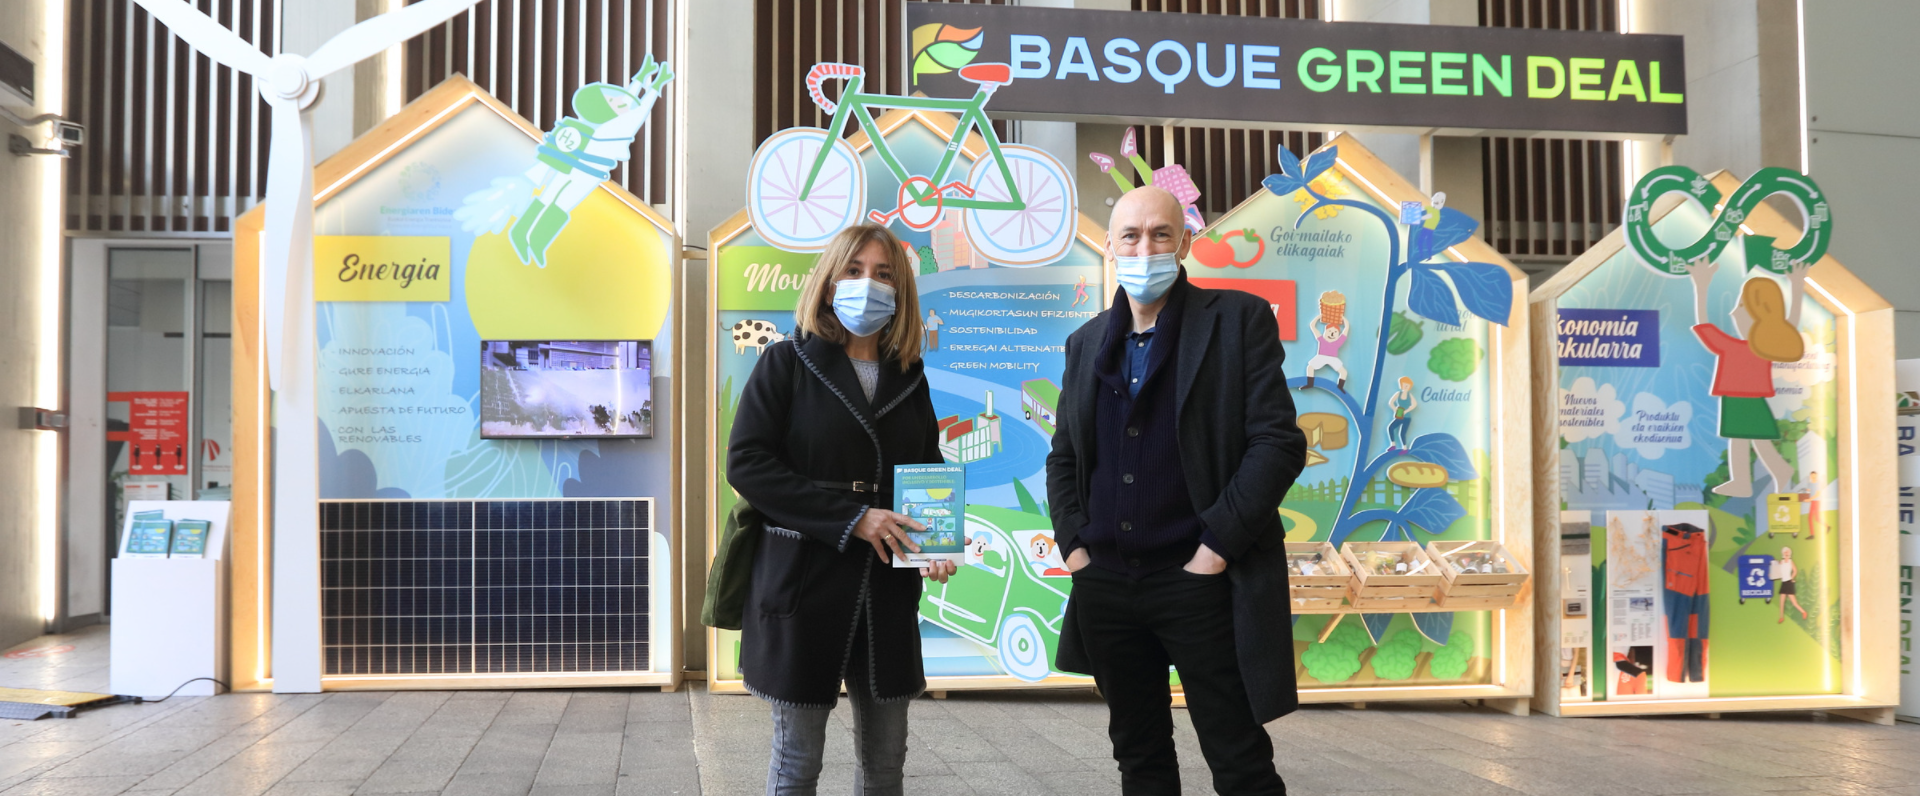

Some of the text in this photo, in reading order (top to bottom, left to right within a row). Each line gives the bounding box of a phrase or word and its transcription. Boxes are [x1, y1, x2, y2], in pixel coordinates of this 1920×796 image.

[1009, 34, 1684, 103] BASQUE GREEN DEAL
[432, 206, 456, 215] Bide
[1270, 225, 1353, 243] Goi-mailako
[1276, 243, 1346, 262] elikagaiak
[338, 253, 441, 289] Energia
[949, 290, 1060, 301] DESCARBONIZACIÓN
[949, 309, 1099, 319] MUGIKORTASUN EFIZIENTE
[949, 326, 1038, 335] SOSTENIBILIDAD
[1557, 314, 1639, 337] konomia
[338, 346, 415, 356] INNOVACIÓN
[950, 344, 1066, 353] ERREGAI ALTERNATIB
[1557, 337, 1643, 359] rkularra
[338, 367, 431, 376] GURE ENERGIA
[950, 361, 1040, 373] GREEN MOBILITY
[338, 387, 415, 395] ELKARLANA
[1421, 386, 1472, 403] Calidad
[1564, 394, 1598, 405] Nuevos
[337, 406, 467, 415] APUESTA DE FUTURO
[1636, 409, 1680, 421] Produktu
[338, 426, 396, 434] CON LAS
[1631, 423, 1645, 432] eta
[338, 435, 422, 443] RENOVABLES
